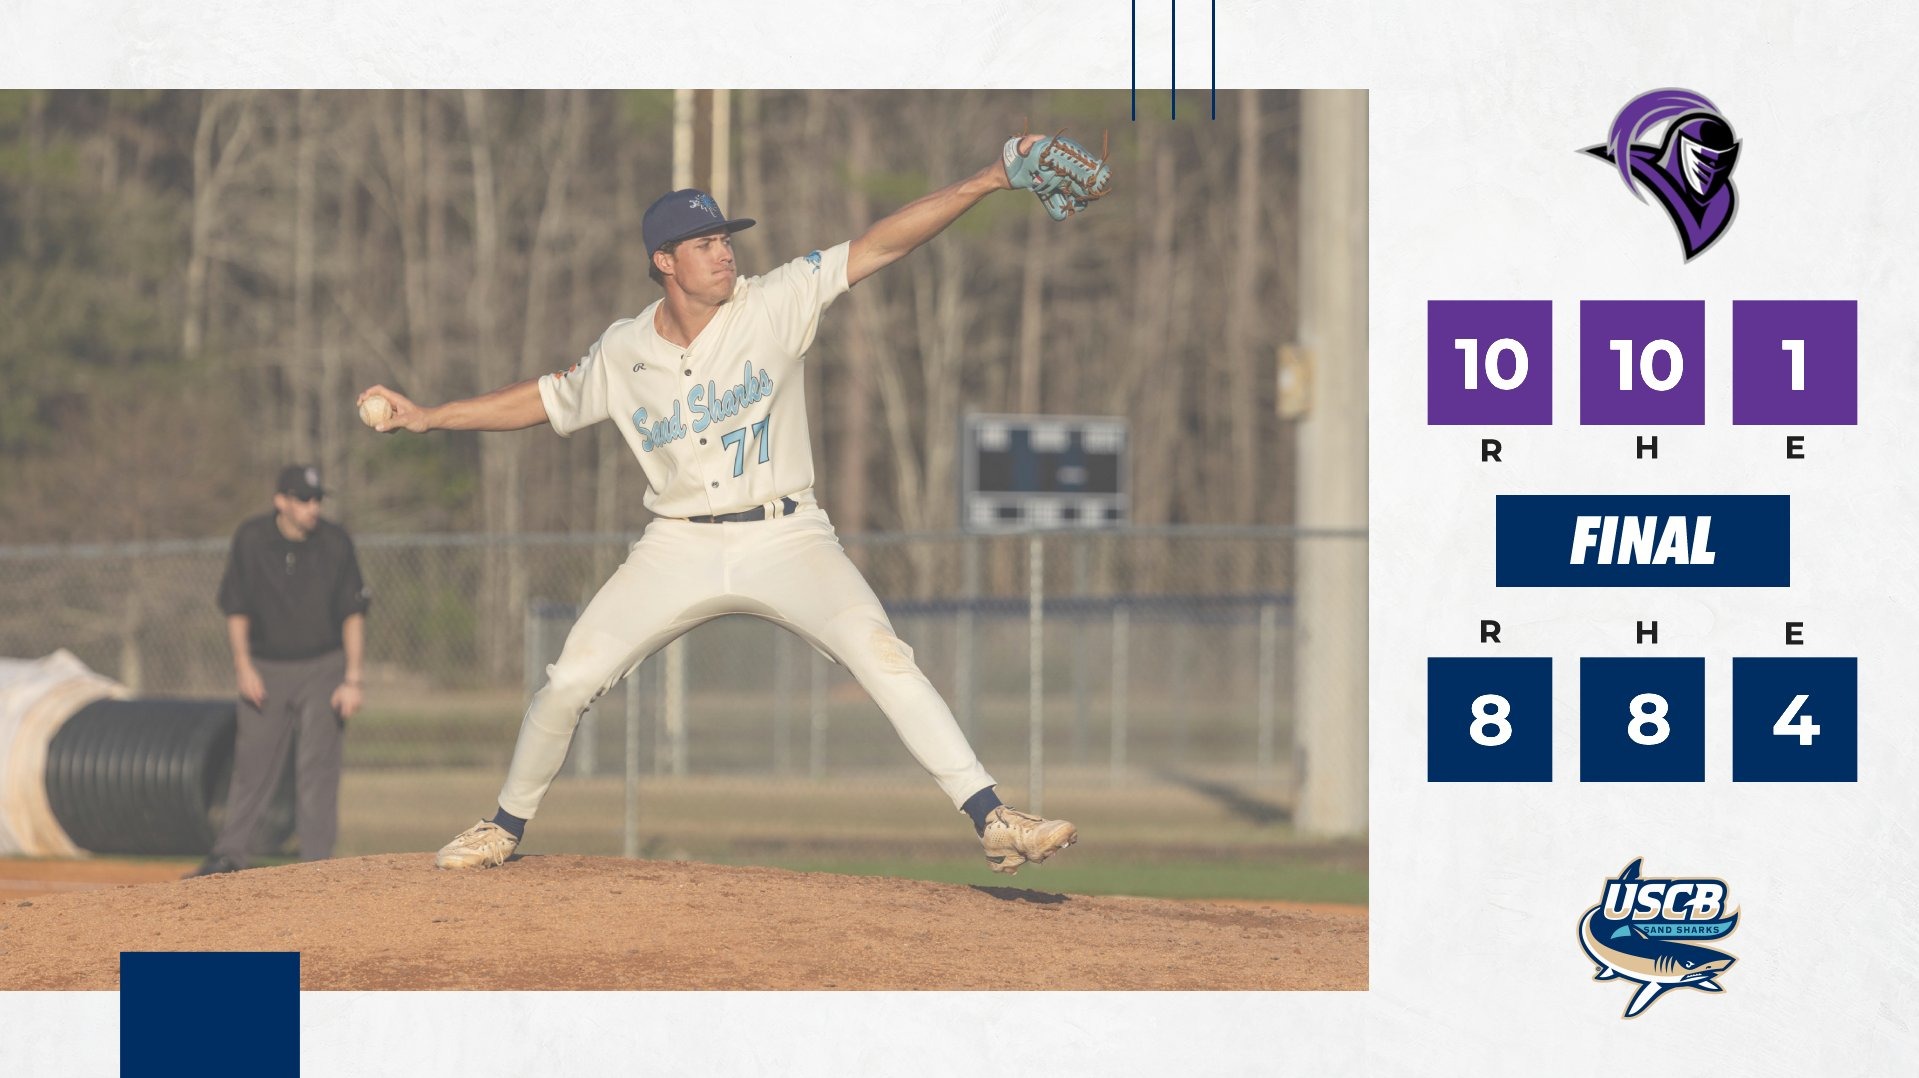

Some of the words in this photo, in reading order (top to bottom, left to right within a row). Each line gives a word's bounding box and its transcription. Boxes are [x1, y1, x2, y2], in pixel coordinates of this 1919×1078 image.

[632, 399, 687, 453] Sand
[687, 360, 774, 433] Sharks
[721, 413, 771, 478] 77
